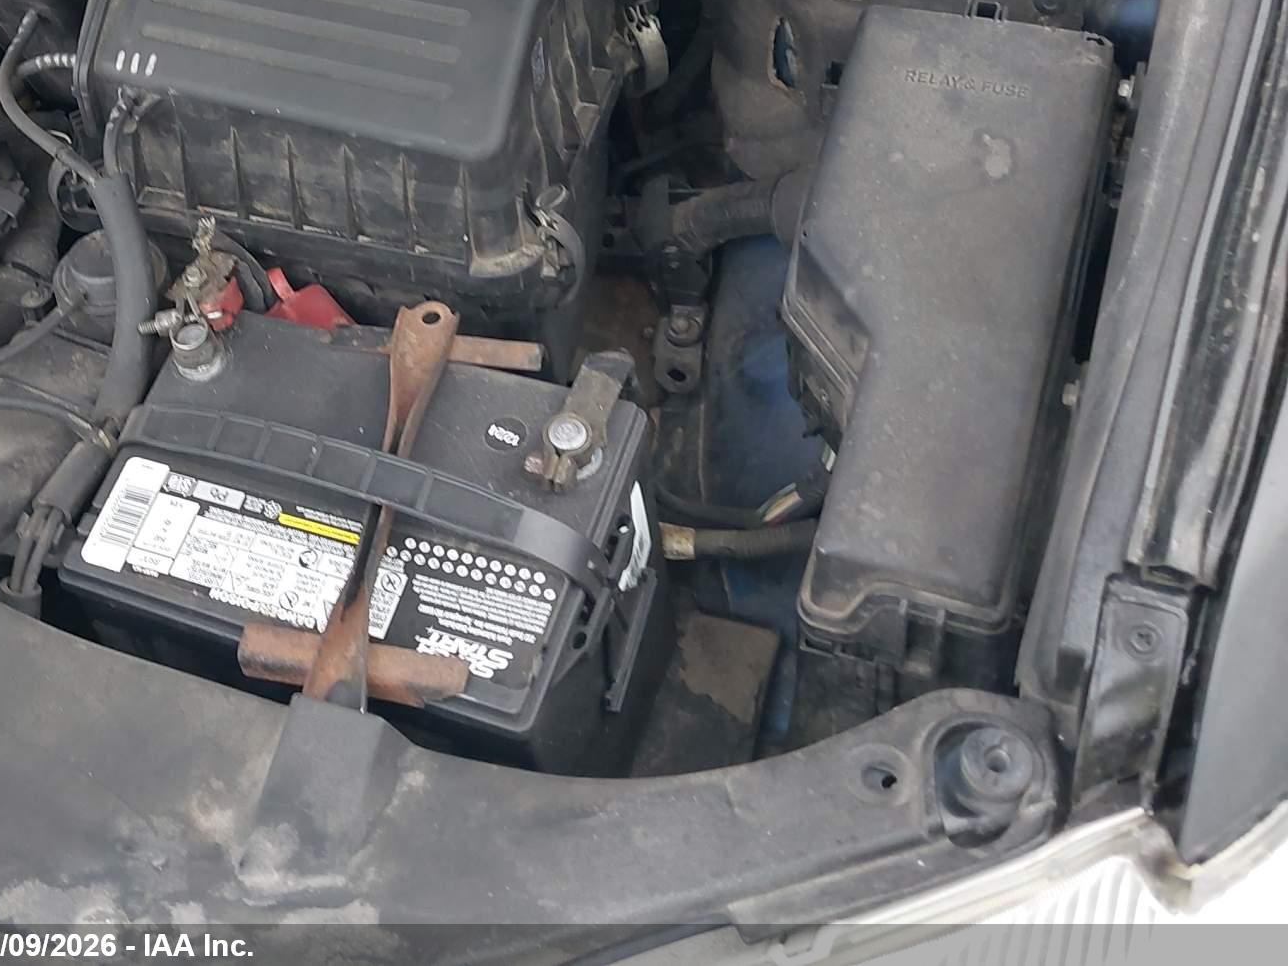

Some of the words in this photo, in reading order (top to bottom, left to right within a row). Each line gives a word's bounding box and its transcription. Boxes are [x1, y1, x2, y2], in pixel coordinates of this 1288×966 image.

[904, 69, 963, 90] RELAY
[964, 78, 975, 91] &
[981, 81, 1030, 99] FUSE
